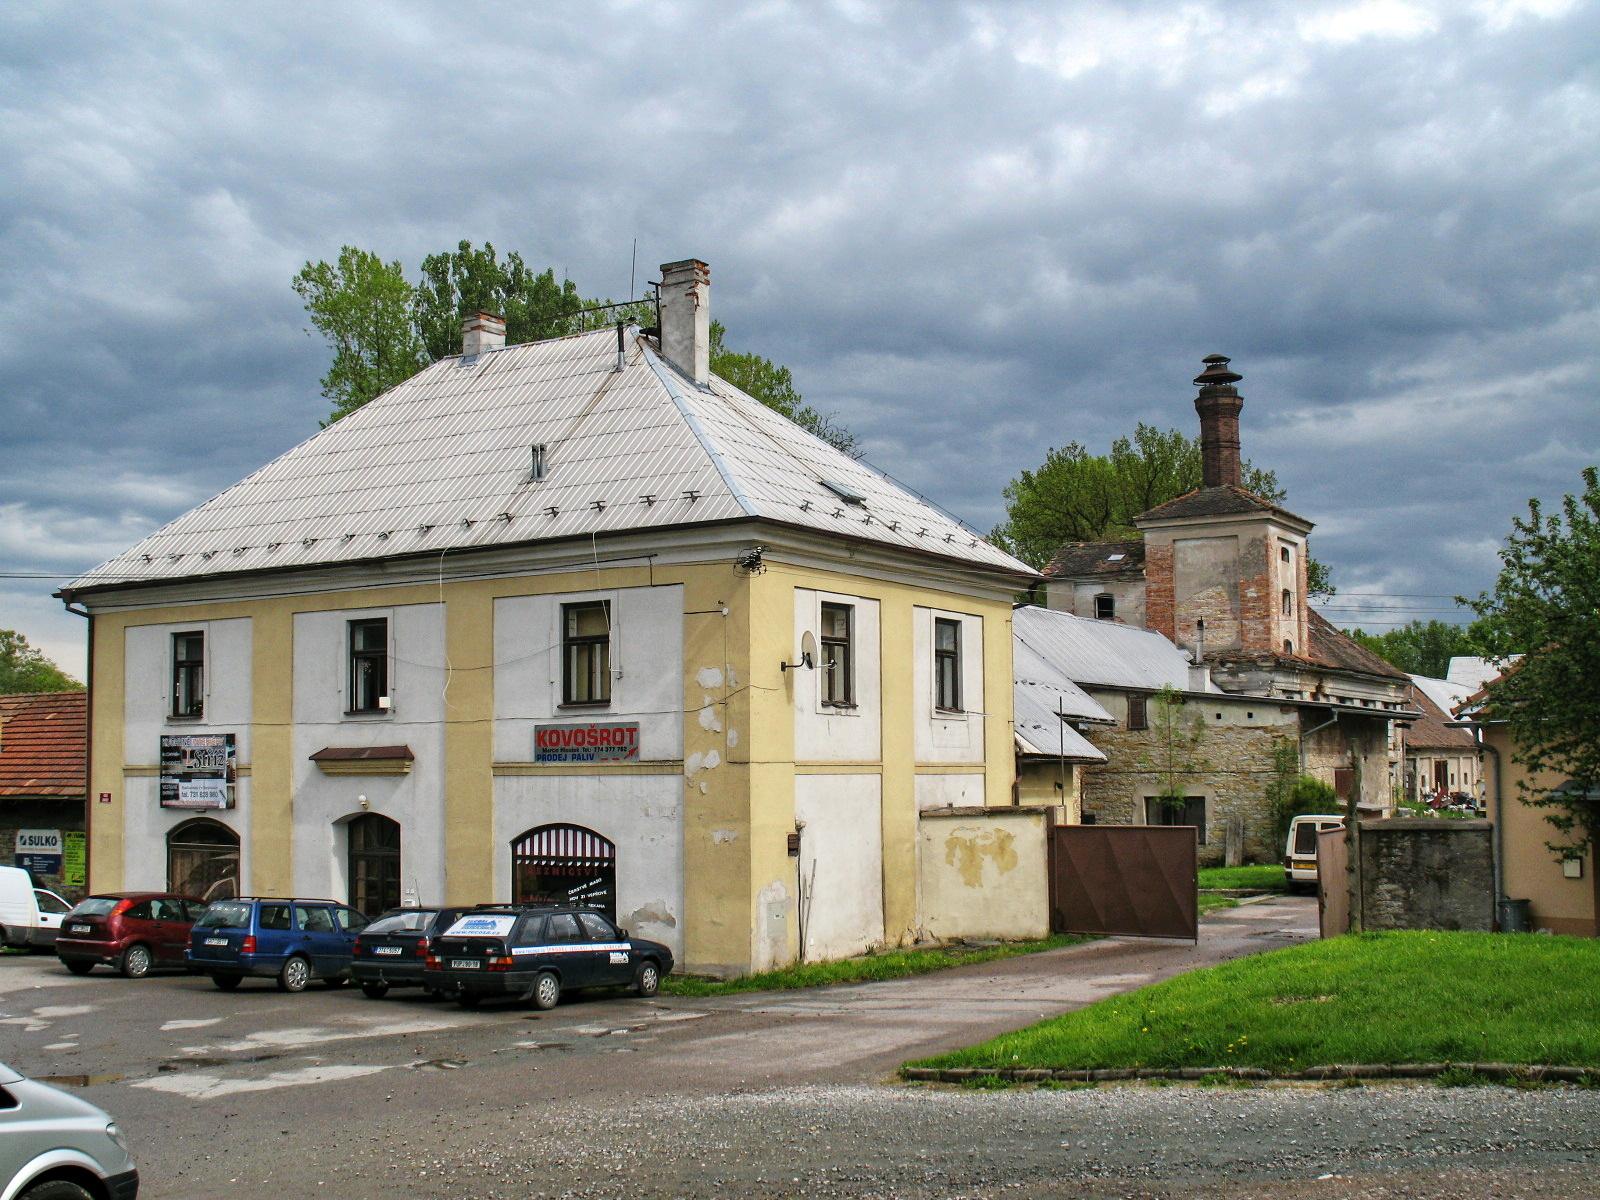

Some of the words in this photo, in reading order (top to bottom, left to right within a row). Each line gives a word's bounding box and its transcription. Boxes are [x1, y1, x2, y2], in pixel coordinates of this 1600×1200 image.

[537, 723, 637, 747] KOVOŠROT
[537, 753, 567, 762] PRODEJ
[572, 753, 594, 762] PALIV
[28, 835, 58, 847] SULKO
